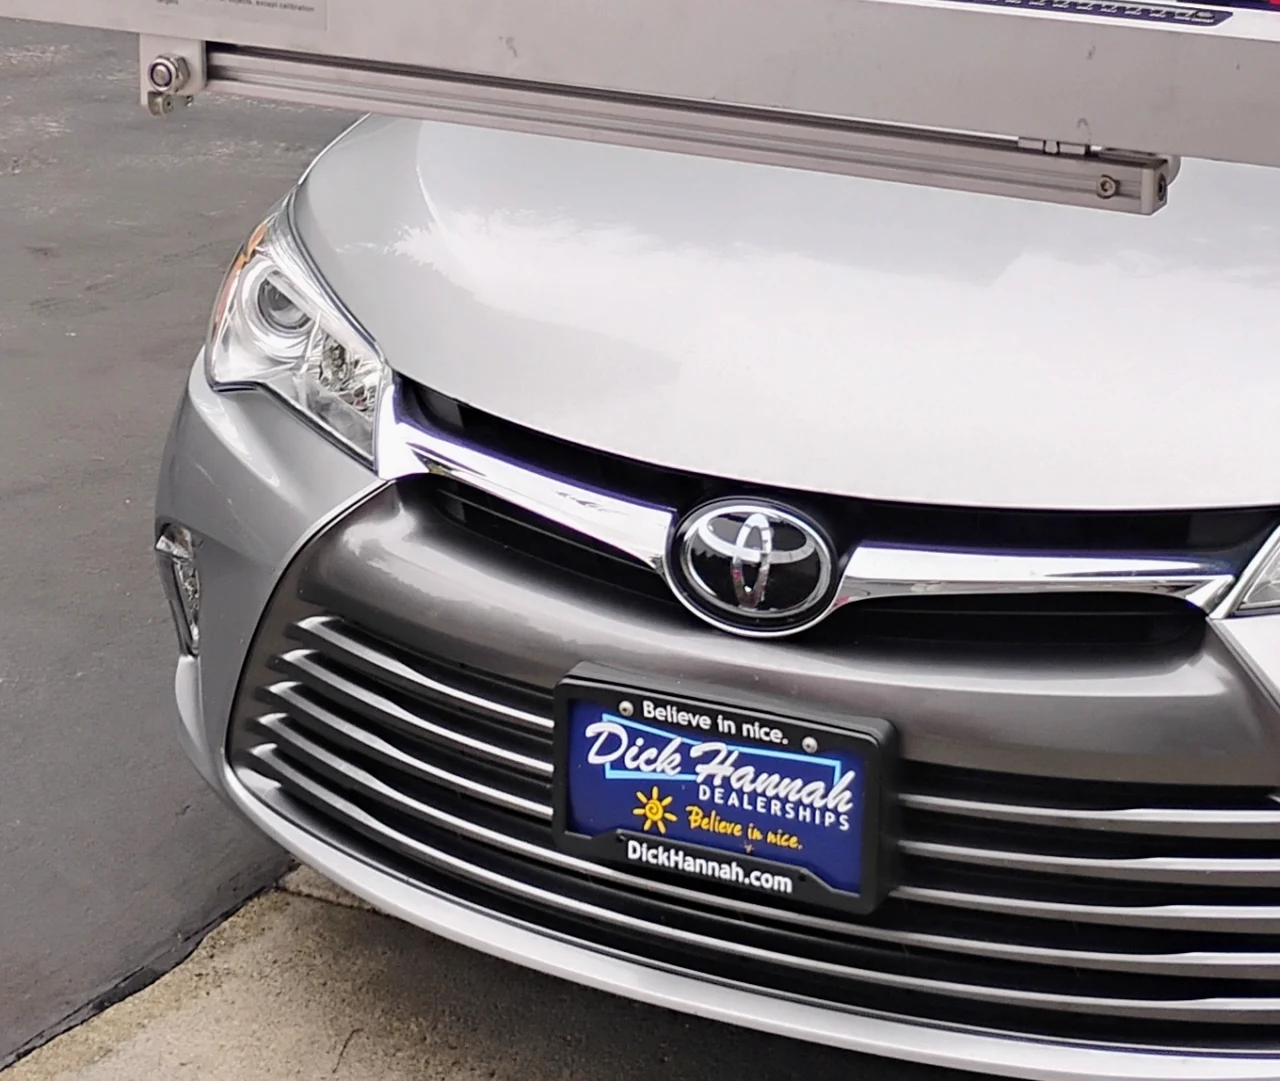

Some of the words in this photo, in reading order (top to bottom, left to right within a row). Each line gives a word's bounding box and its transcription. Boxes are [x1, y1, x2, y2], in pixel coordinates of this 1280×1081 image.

[279, 1, 314, 12] calibration
[642, 700, 711, 732] Believe
[716, 714, 737, 735] in
[742, 719, 789, 745] nice.
[584, 721, 684, 777] Dick
[689, 741, 857, 814] Hannah
[685, 804, 743, 838] Believe
[747, 823, 763, 841] in
[766, 829, 803, 850] nice.
[698, 784, 850, 831] DEALERSHIPS
[627, 839, 793, 894] DickHannah.com
